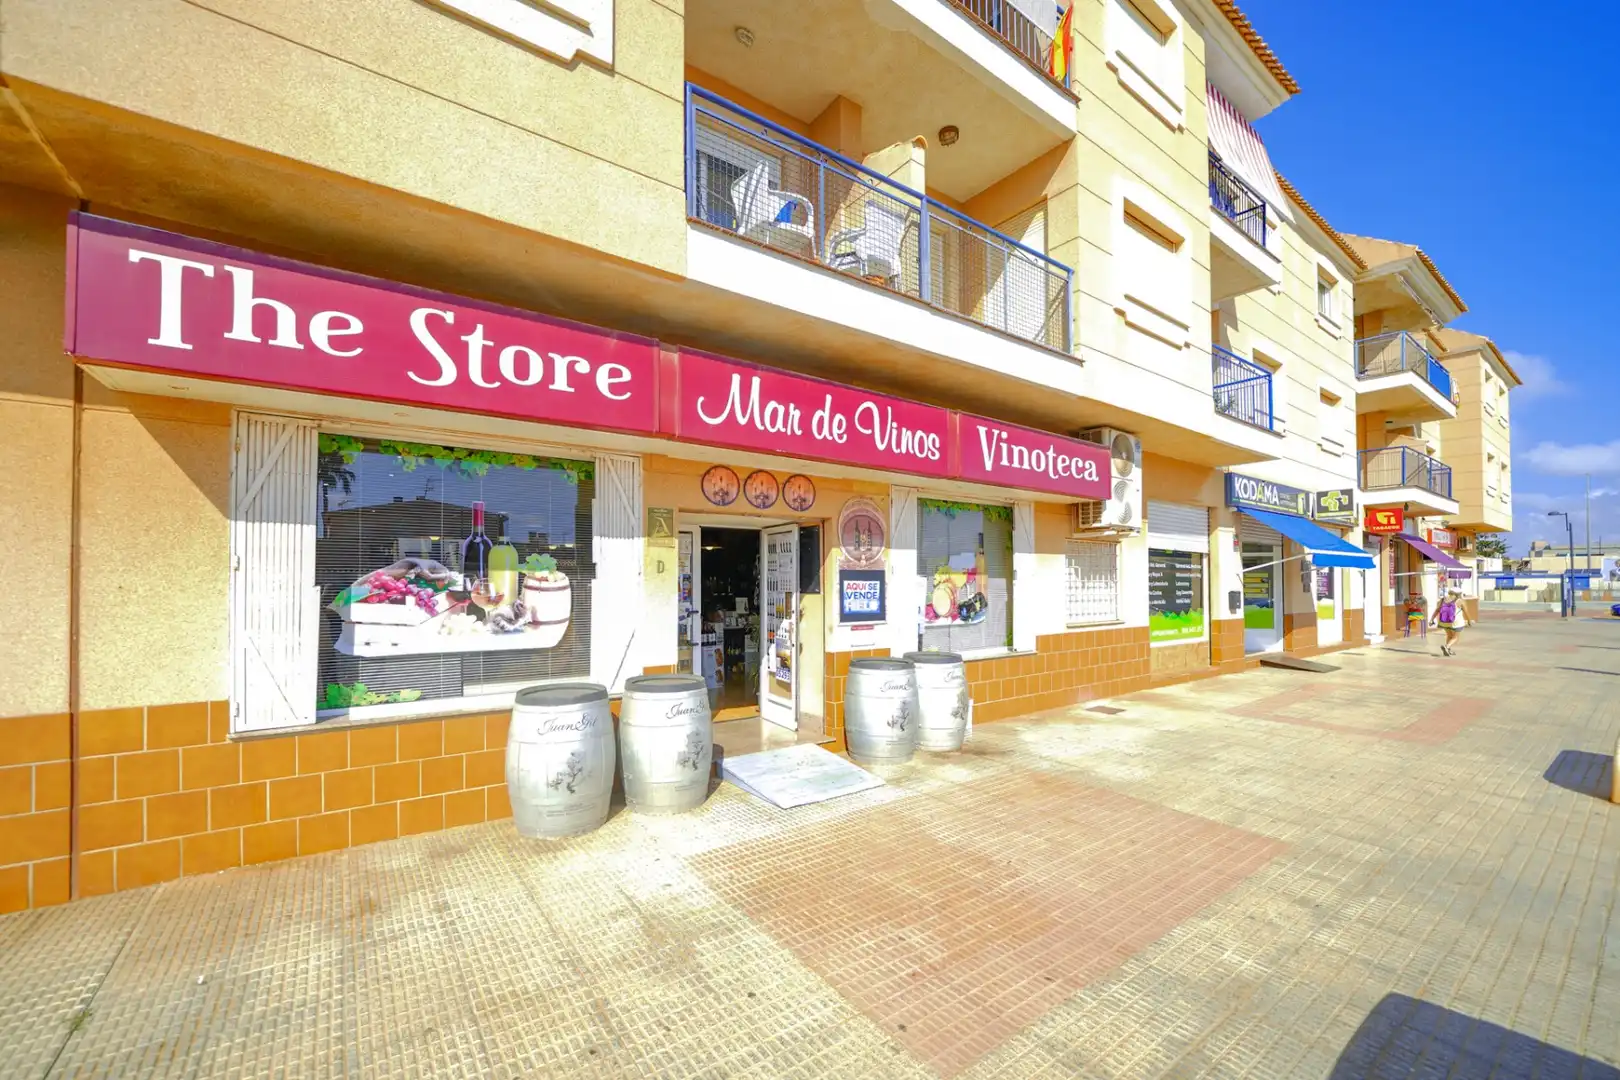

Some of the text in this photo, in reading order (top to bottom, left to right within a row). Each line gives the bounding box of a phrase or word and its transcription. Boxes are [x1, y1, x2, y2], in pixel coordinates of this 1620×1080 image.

[128, 248, 632, 400] The Store
[696, 372, 941, 461] Mar de Vinos
[976, 425, 1100, 482] Vinoteca
[1234, 476, 1280, 506] KODAMA
[656, 560, 666, 574] D
[846, 591, 878, 600] VENDE
[868, 582, 878, 591] SE
[665, 702, 697, 719] Juan
[537, 717, 575, 736] Juan
